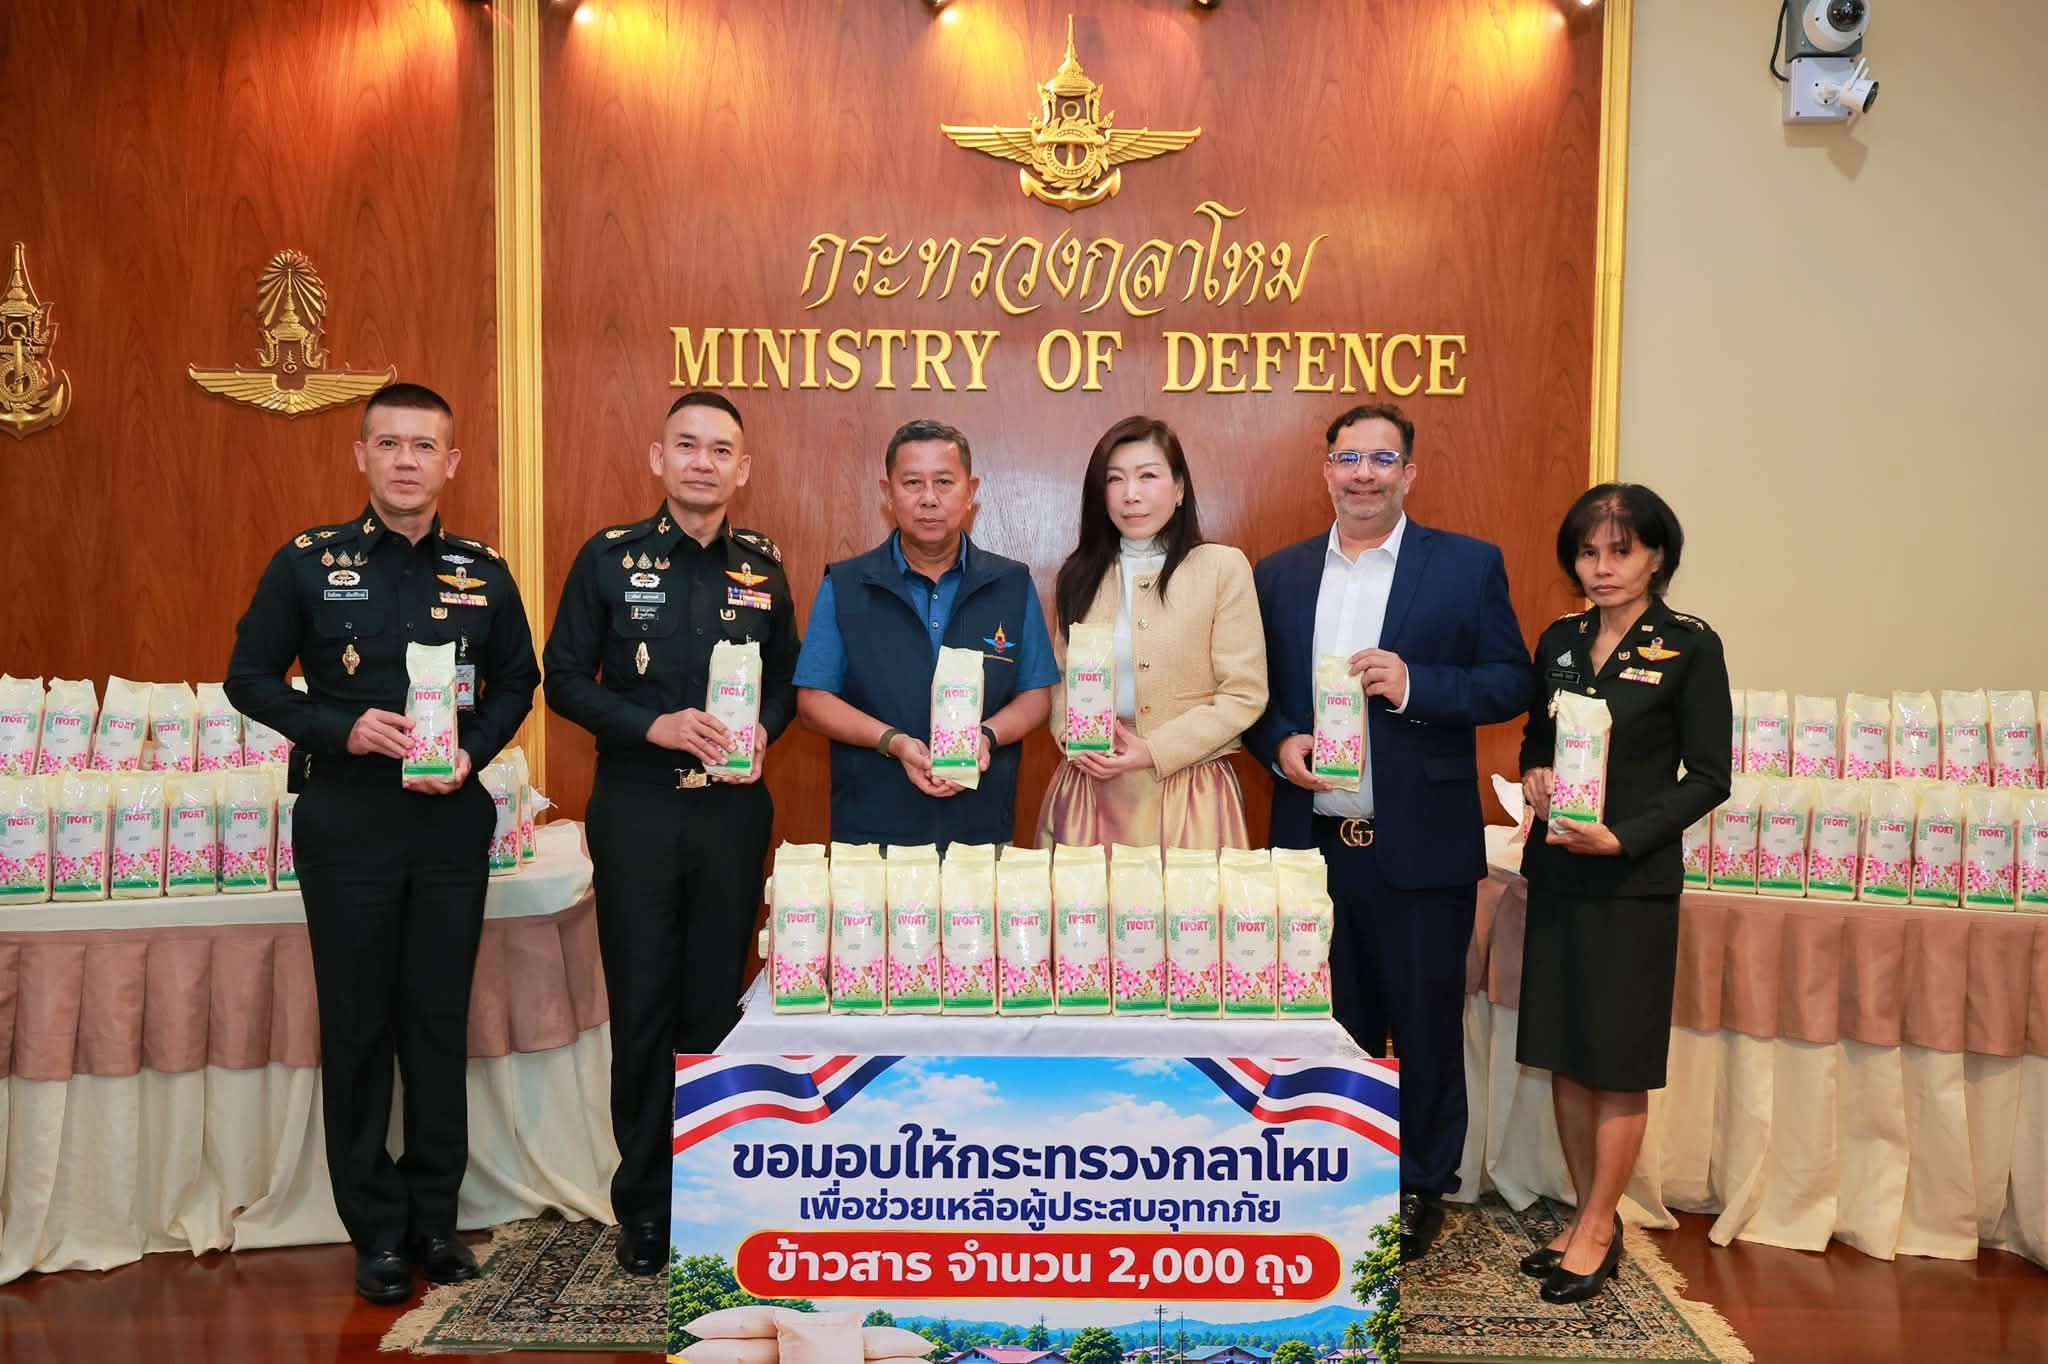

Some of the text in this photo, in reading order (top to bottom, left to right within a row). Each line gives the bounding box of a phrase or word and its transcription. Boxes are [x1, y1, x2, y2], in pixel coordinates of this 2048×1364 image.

[802, 200, 1330, 316] กระทรวงกลาโหม
[669, 326, 1467, 396] MINISTRY OF DEFENCE
[732, 1123, 1349, 1183] ขอมอบให้กระทรวงกลาโหม
[799, 1181, 1281, 1232] เพื่อช่วยเหลือผู้ประสบอุทกภัย
[768, 1239, 1314, 1297] ข้าวสาร จำนวน 2,000 ถุง
